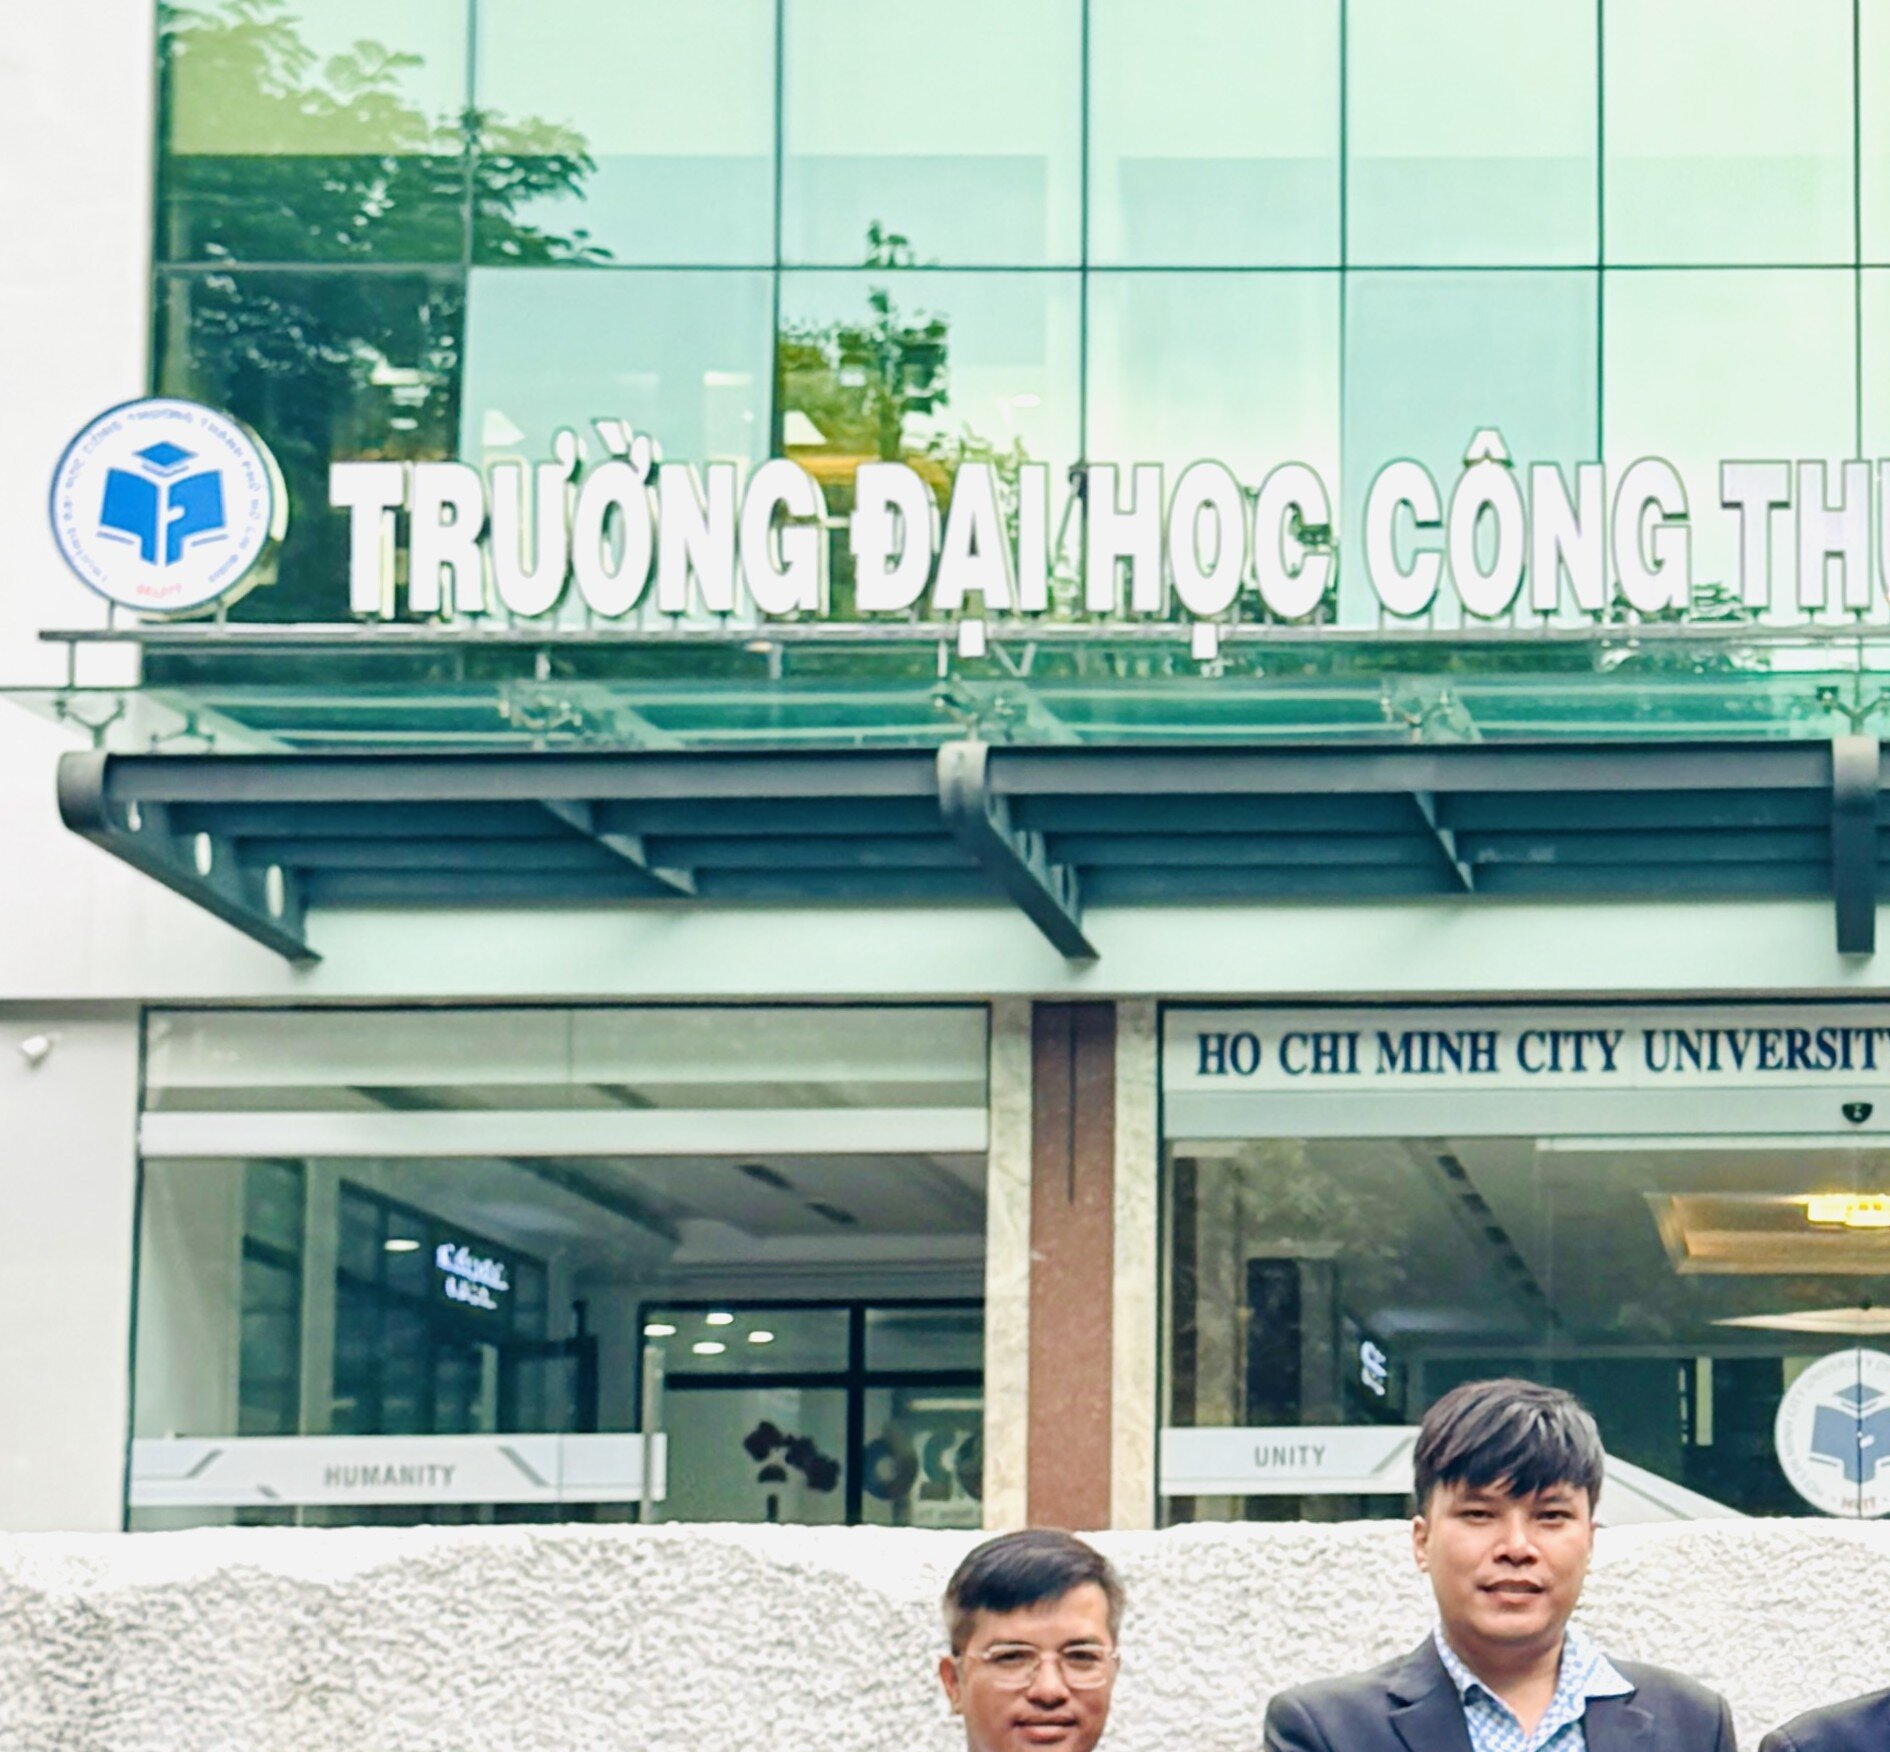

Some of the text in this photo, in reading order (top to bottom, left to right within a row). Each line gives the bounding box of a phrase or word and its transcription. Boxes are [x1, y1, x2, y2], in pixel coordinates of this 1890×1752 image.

[329, 417, 826, 617] TRƯỜNG
[850, 460, 1050, 658] ĐẠI
[1085, 458, 1336, 659] HỌC
[1365, 427, 1692, 618] CÔNG
[1196, 1031, 1261, 1075] HO
[1277, 1030, 1361, 1075] CHI
[1375, 1030, 1500, 1074] MINH
[1517, 1029, 1624, 1074] CITY
[1254, 1444, 1326, 1468] UNITY
[323, 1463, 457, 1489] HUMANITY
